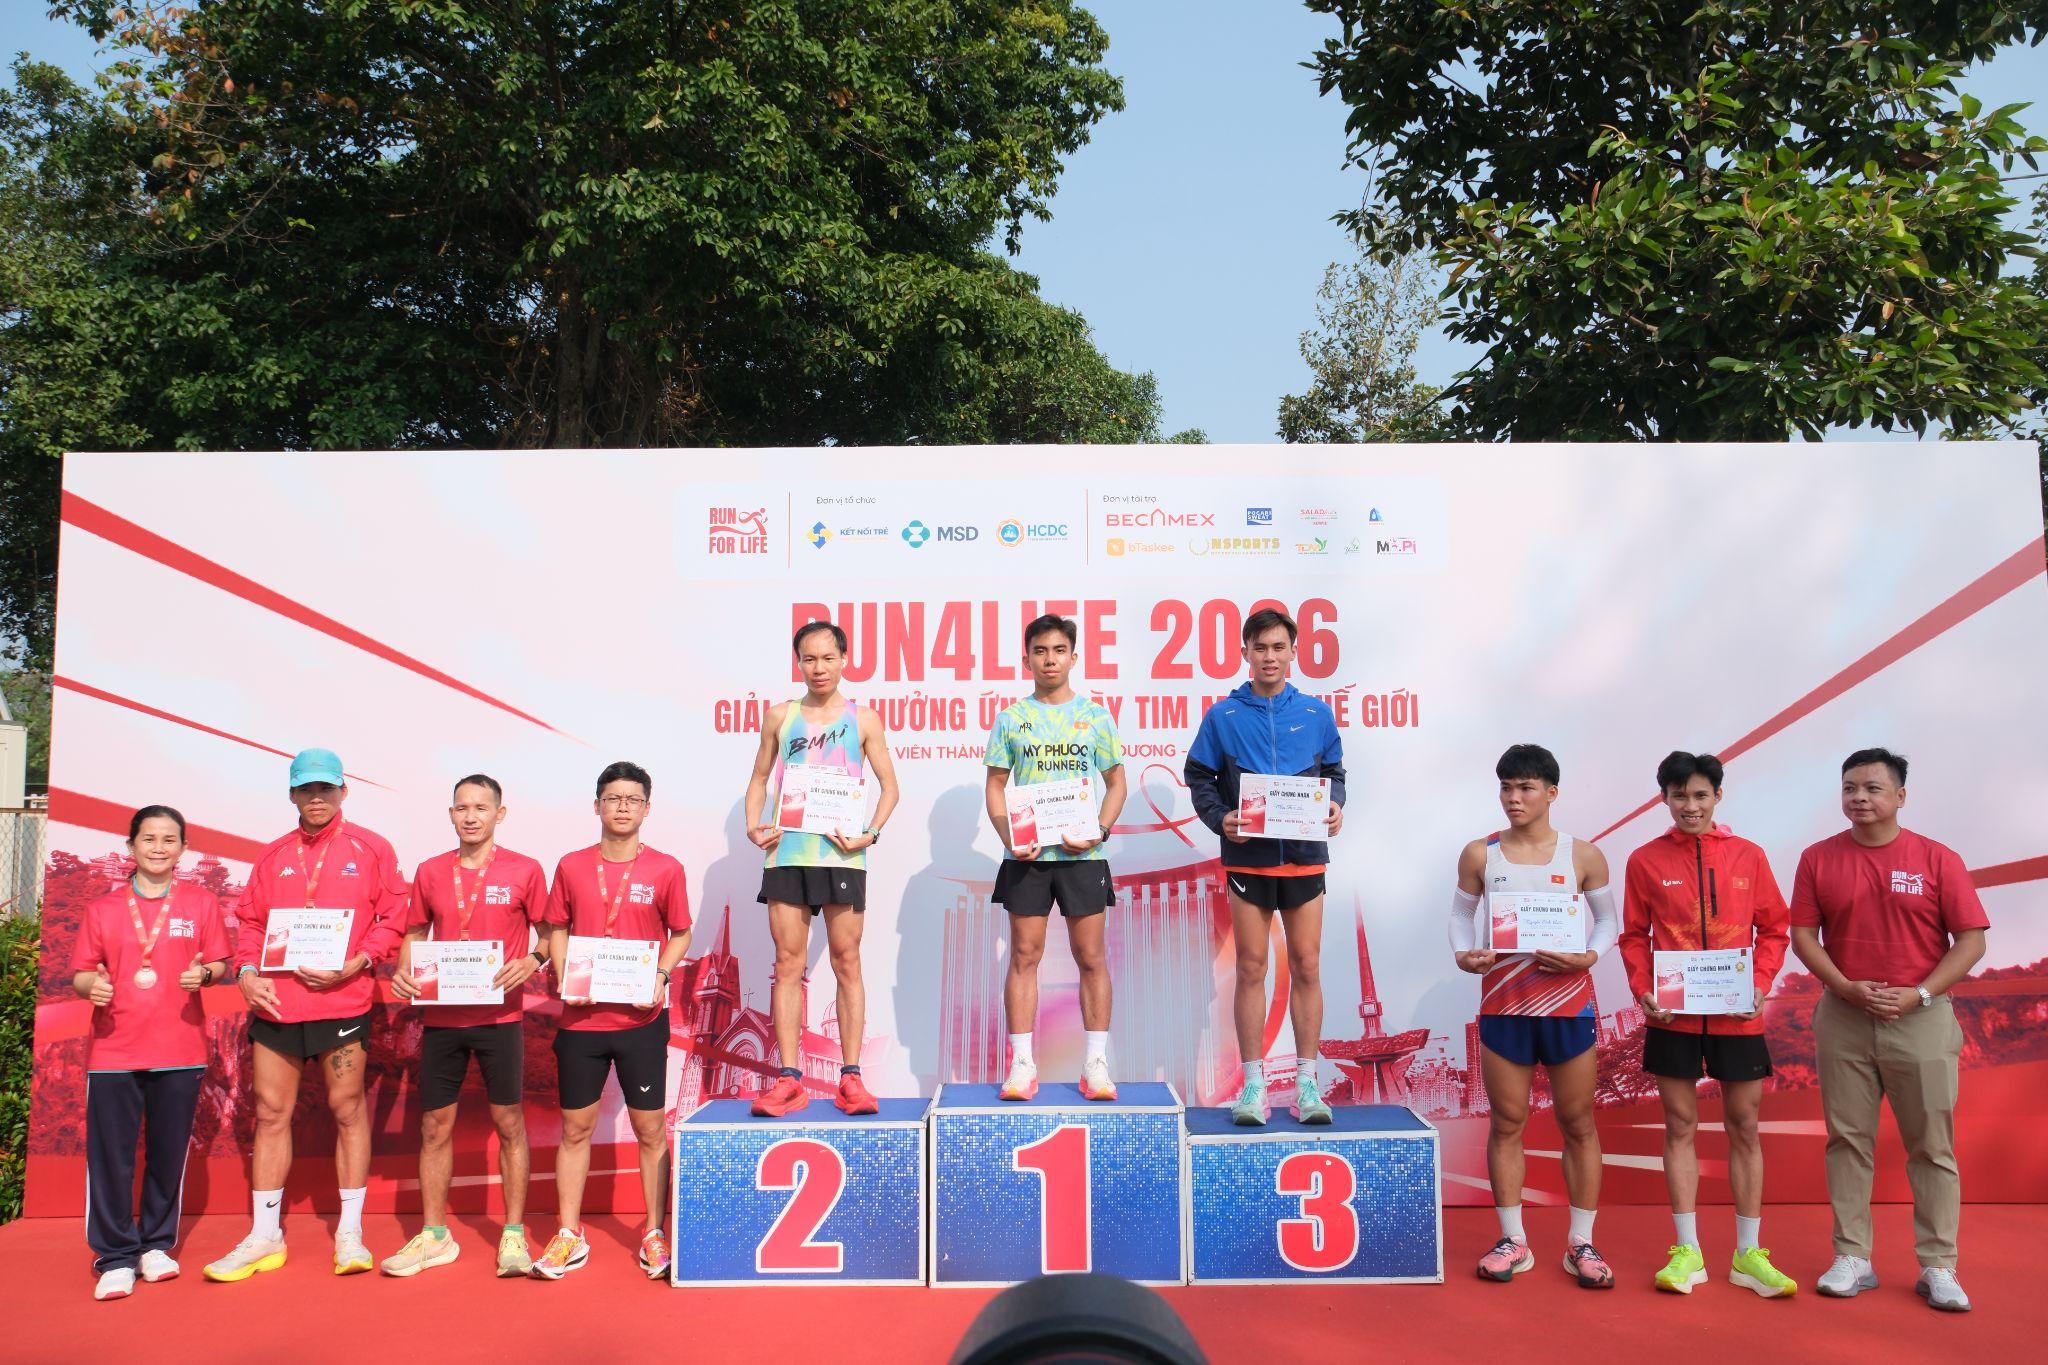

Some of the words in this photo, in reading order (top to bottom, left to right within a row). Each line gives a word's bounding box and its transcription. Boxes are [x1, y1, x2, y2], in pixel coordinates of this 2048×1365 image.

[816, 496, 833, 504] Đơn
[1103, 494, 1120, 503] Đơn
[709, 507, 737, 525] RUN
[1106, 508, 1216, 527] BECAMEX
[840, 526, 856, 536] KẾT
[857, 526, 872, 536] NỐI
[873, 526, 889, 536] TRẺ
[937, 526, 979, 542] MSD
[1027, 524, 1068, 537] HCDC
[708, 536, 735, 554] FOR
[740, 536, 768, 554] LIFE
[1128, 542, 1175, 553] bTaskee
[1150, 597, 1340, 680] 206
[869, 690, 966, 732] HƯỞNG
[1134, 695, 1188, 730] TIM
[1361, 687, 1420, 728] GIỚI
[895, 744, 933, 760] VIÊN
[1023, 744, 1042, 758] MY
[1045, 743, 1089, 757] PHUOC
[1037, 758, 1089, 772] RUNNERS
[1891, 870, 1907, 880] RUN
[1891, 883, 1906, 893] FOR
[1907, 884, 1923, 896] LIFE
[755, 1137, 847, 1274] 2
[1012, 1122, 1092, 1275] 1
[1276, 1150, 1361, 1273] 3
